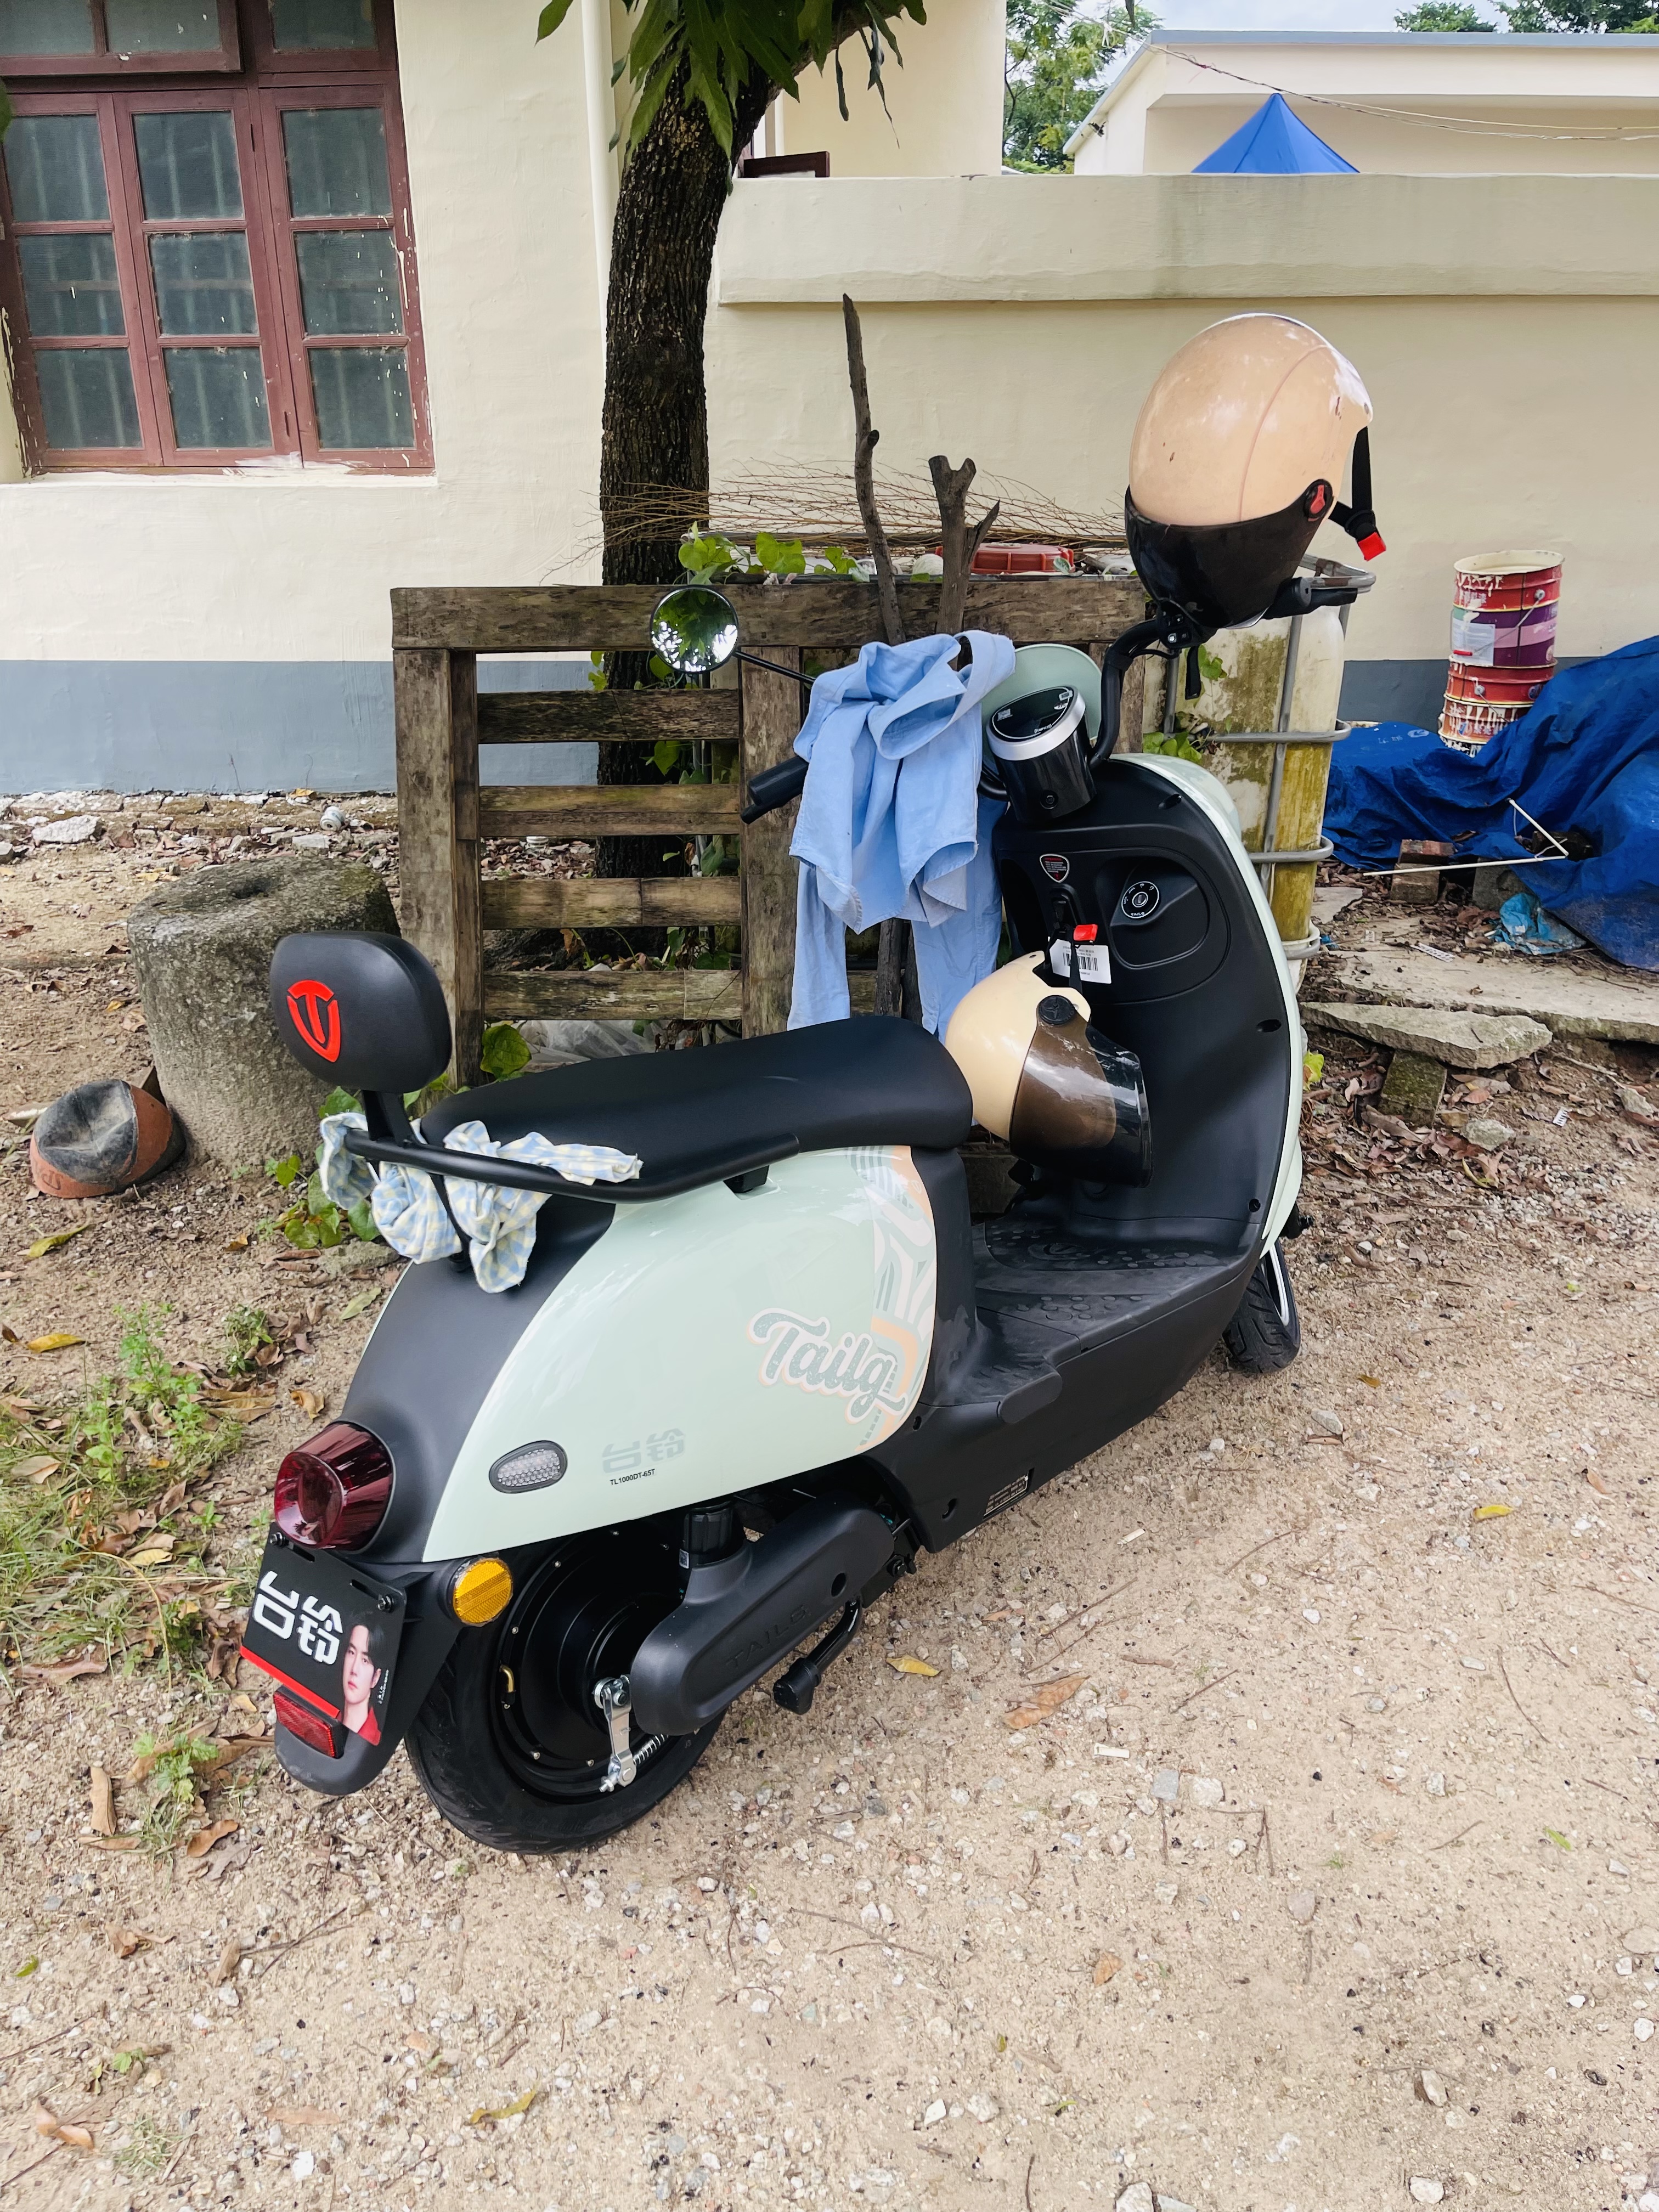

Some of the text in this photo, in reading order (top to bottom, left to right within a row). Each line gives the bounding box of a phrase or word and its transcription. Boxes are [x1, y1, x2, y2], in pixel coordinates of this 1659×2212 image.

[747, 1308, 908, 1423] Tailg
[602, 1428, 685, 1473] 台铃
[610, 1469, 655, 1485] TL1000DT-65T
[253, 1571, 343, 1665] 台铃
